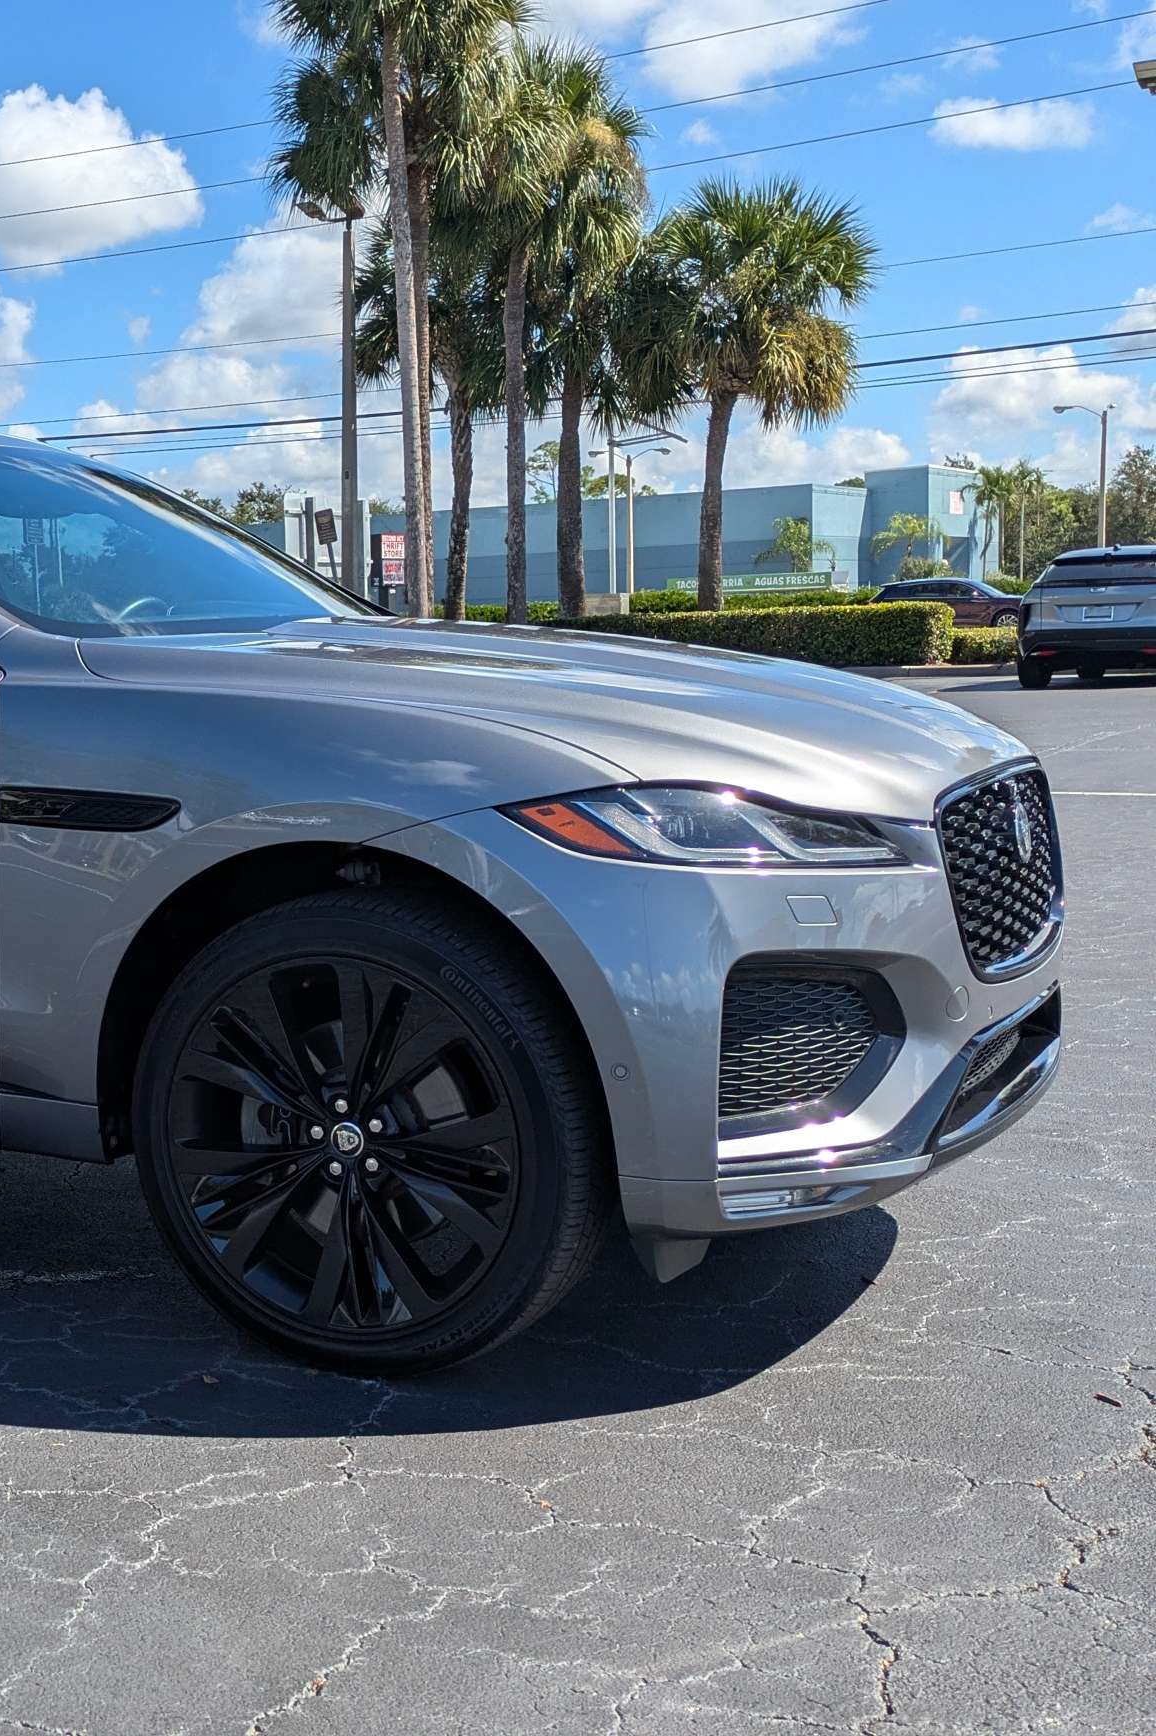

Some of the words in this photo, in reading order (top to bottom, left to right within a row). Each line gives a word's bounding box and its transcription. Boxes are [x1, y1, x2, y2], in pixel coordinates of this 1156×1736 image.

[676, 580, 700, 589] TACO
[754, 576, 784, 586] AGUAS
[786, 574, 826, 585] FRESCAS
